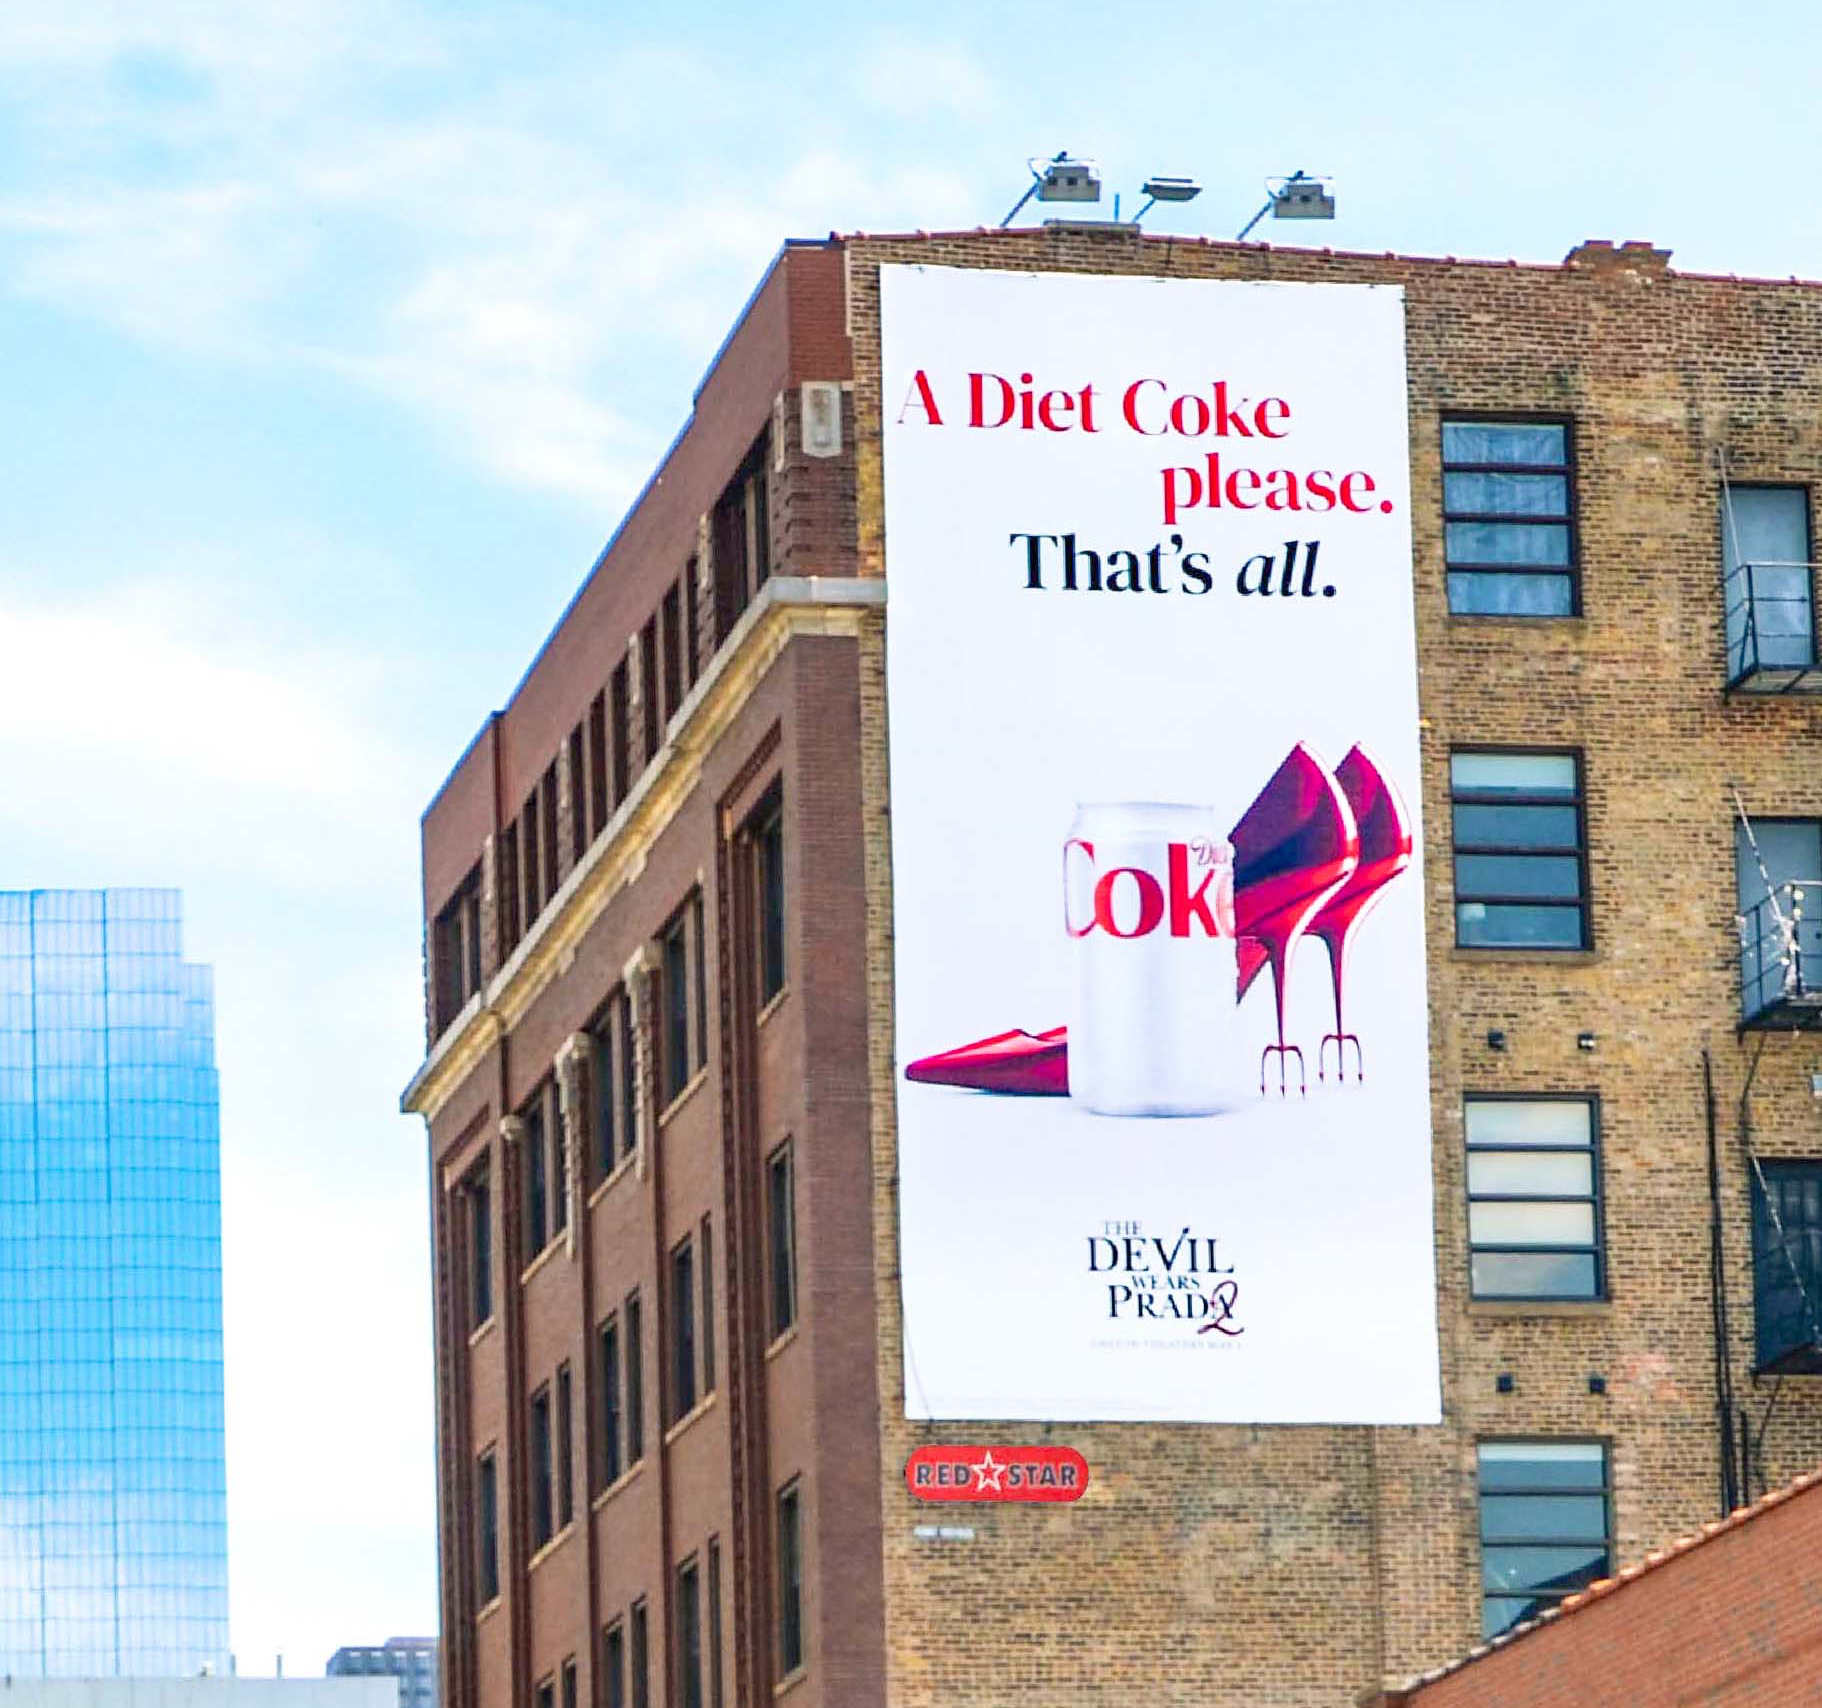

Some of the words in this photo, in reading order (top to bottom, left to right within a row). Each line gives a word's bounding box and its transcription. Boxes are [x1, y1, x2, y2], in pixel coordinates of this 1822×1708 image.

[897, 370, 944, 425] A
[967, 372, 1102, 433] Diet
[1122, 379, 1291, 438] Coke
[1160, 452, 1394, 525] please.
[1236, 541, 1336, 598] all.
[1087, 1225, 1234, 1273] DEVIL
[1131, 1275, 1200, 1290] WEARS
[915, 1463, 971, 1486] RED
[1008, 1463, 1077, 1487] STAR
